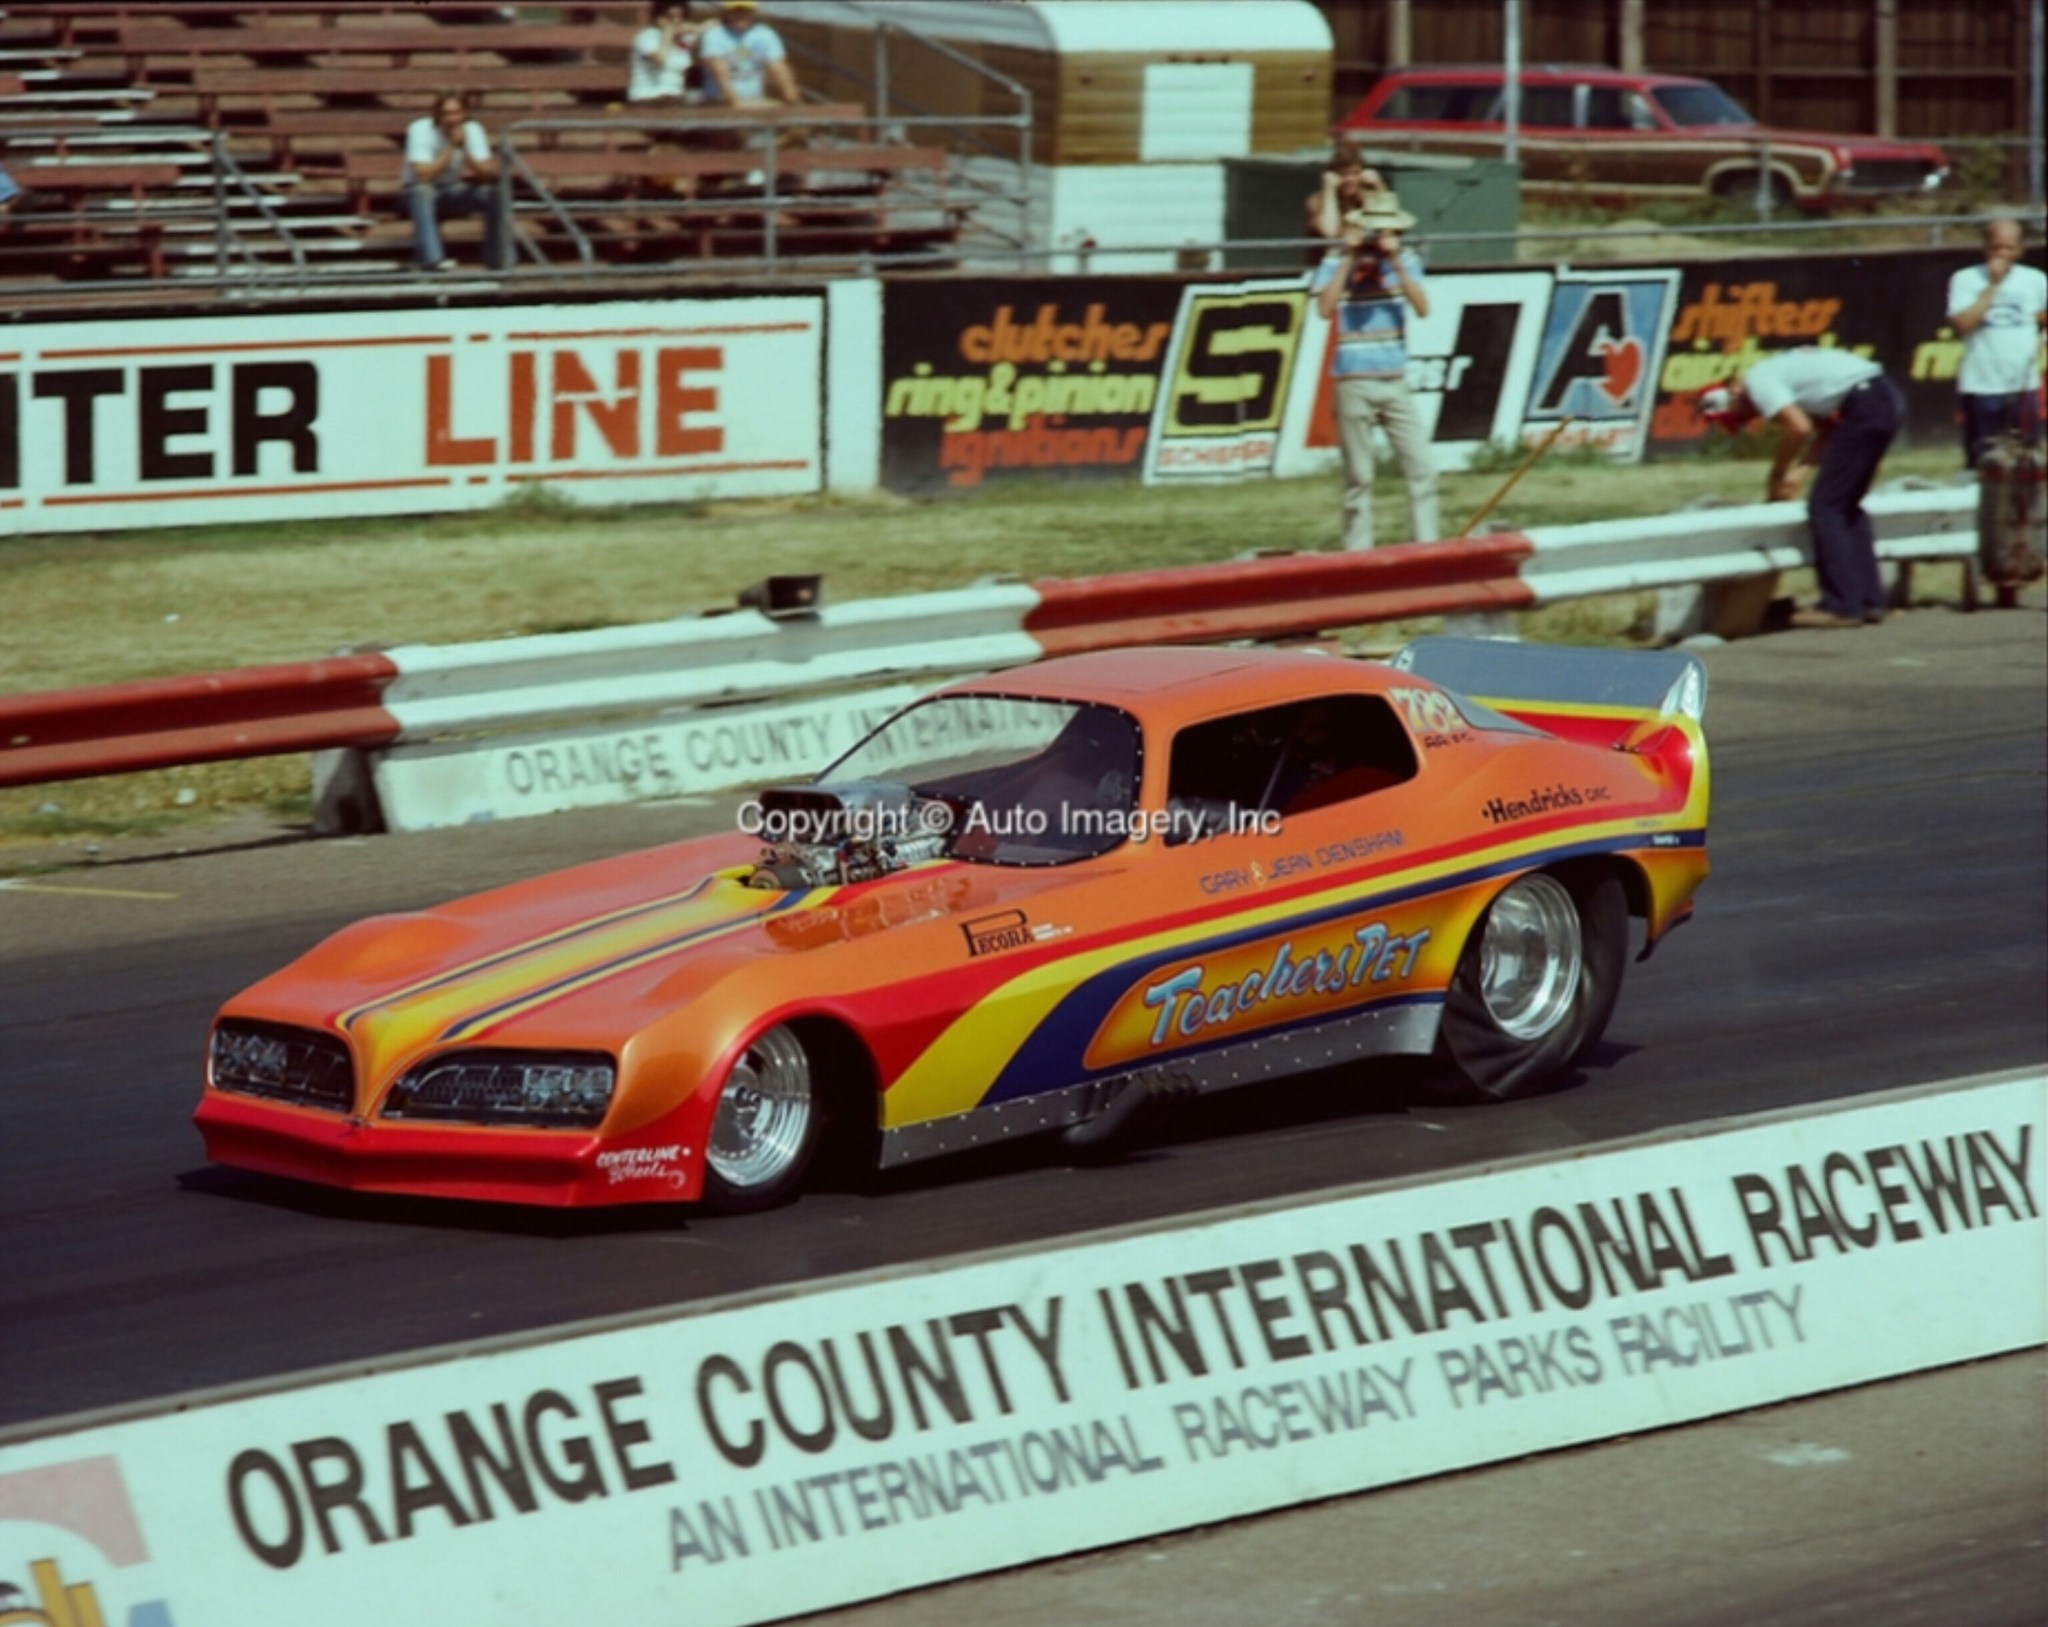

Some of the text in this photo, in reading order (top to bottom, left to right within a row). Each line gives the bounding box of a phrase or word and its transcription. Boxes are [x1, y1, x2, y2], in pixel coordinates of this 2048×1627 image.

[960, 304, 1171, 362] clutches
[1176, 301, 1292, 426] S
[0, 346, 724, 489] TER LINE
[504, 733, 673, 796] ORANGE
[685, 712, 832, 772] COUNTY
[1486, 784, 1583, 824] Hendricks
[1267, 852, 1312, 879] JEAN
[227, 1124, 2040, 1569] ORANGE COUNTY INTERNATIONAL RACEWAY
[669, 1283, 1806, 1572] AN INTERNATIONAL RACEWAY PARKS FACILITY
